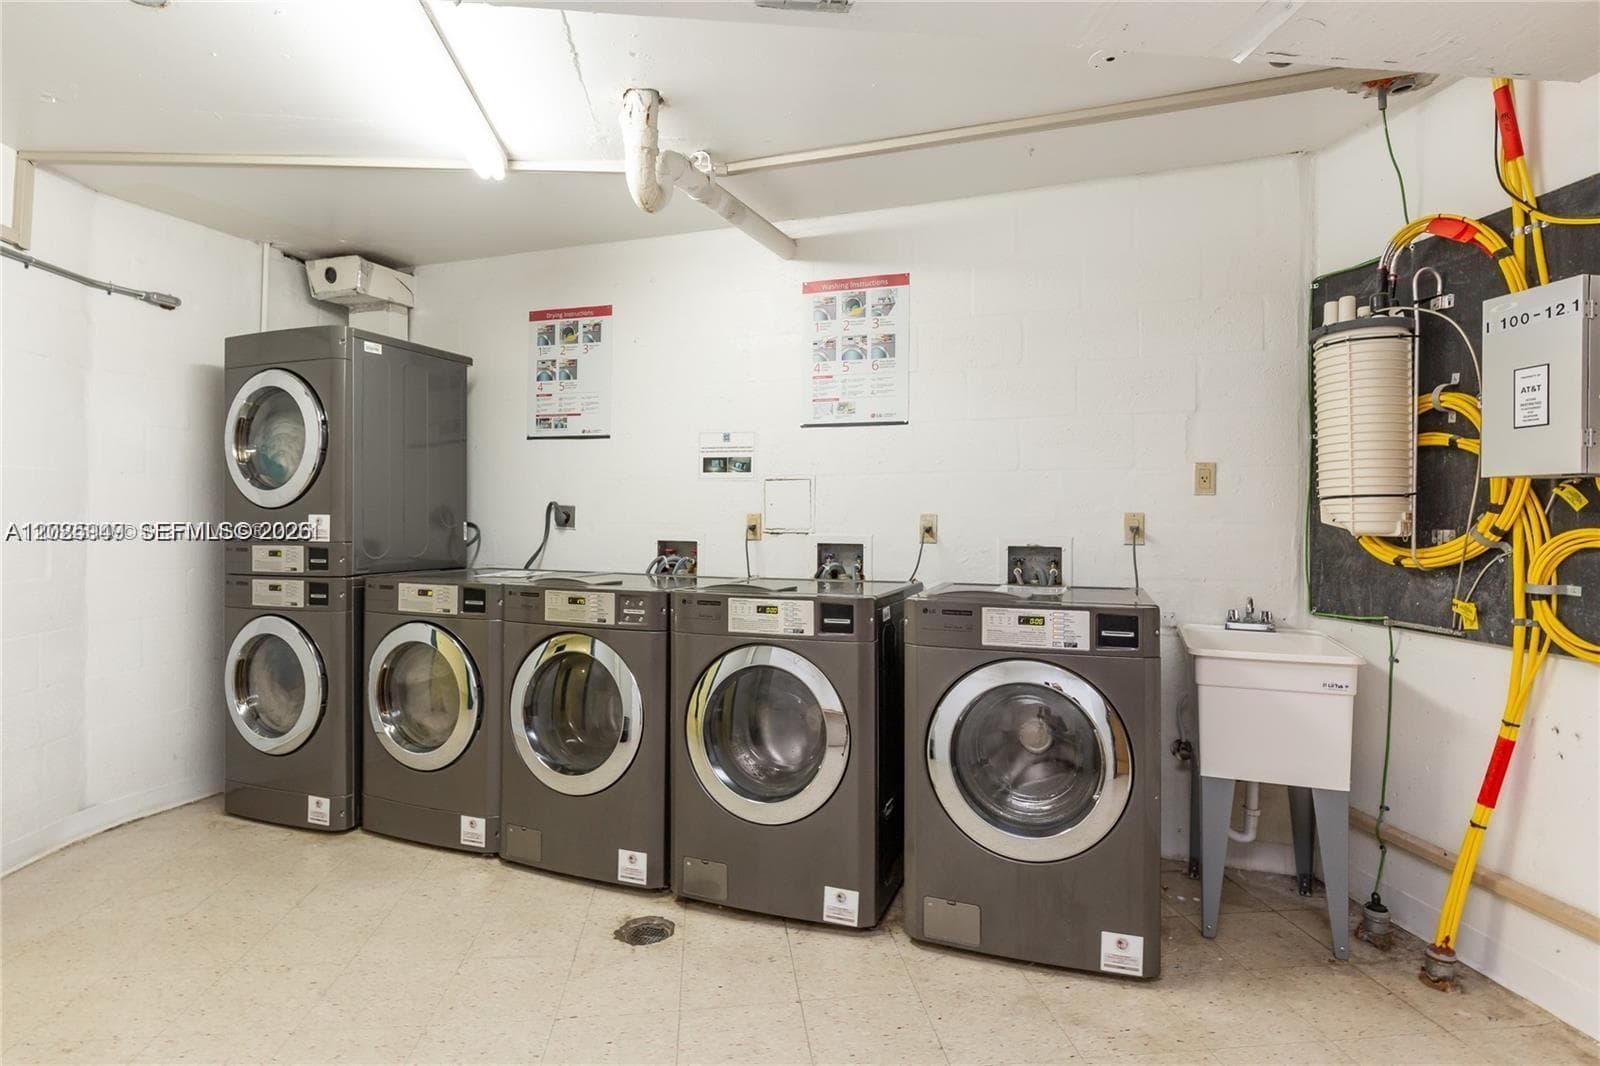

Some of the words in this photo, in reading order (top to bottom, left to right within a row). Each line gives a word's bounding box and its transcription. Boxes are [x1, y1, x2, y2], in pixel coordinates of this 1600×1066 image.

[822, 281, 849, 291] Washing
[849, 278, 889, 288] Instructions
[546, 312, 563, 320] Drying
[563, 309, 594, 318] Instructions
[842, 320, 850, 331] 2
[872, 317, 880, 329] 3
[559, 346, 566, 356] 2
[582, 344, 589, 354] 3
[814, 363, 820, 374] 4
[842, 361, 849, 373] 5
[871, 359, 879, 371] 6
[537, 382, 543, 393] 4
[559, 382, 565, 392] 5
[1520, 384, 1542, 394] AT&T
